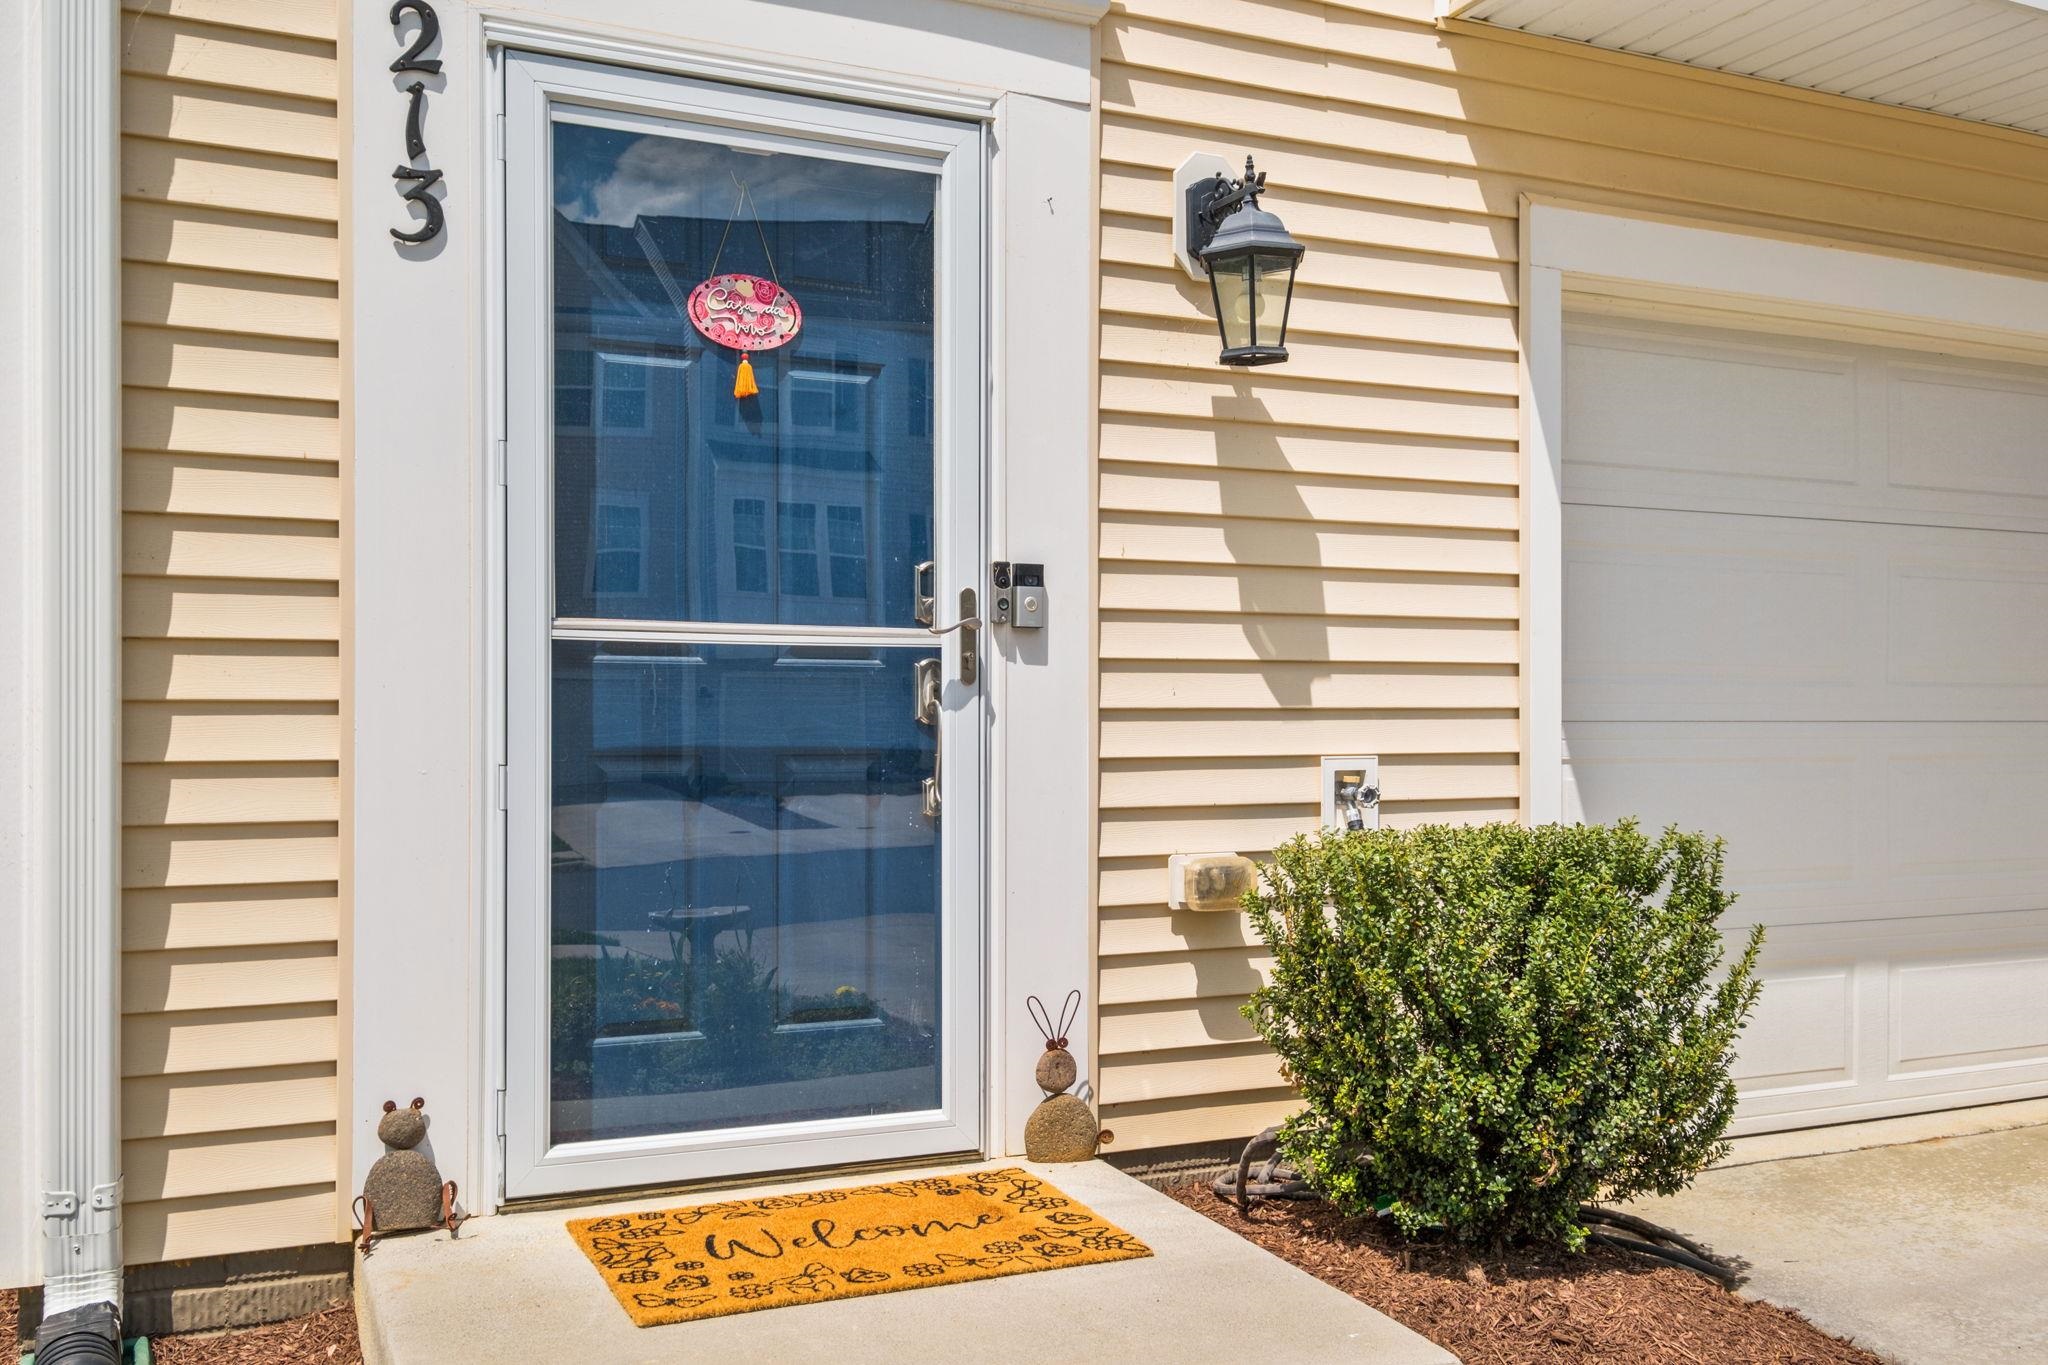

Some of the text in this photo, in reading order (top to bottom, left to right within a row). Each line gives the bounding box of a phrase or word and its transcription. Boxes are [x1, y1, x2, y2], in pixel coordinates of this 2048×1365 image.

[389, 0, 444, 242] 213
[707, 287, 789, 318] Casa da
[705, 1213, 1003, 1260] Welcome
